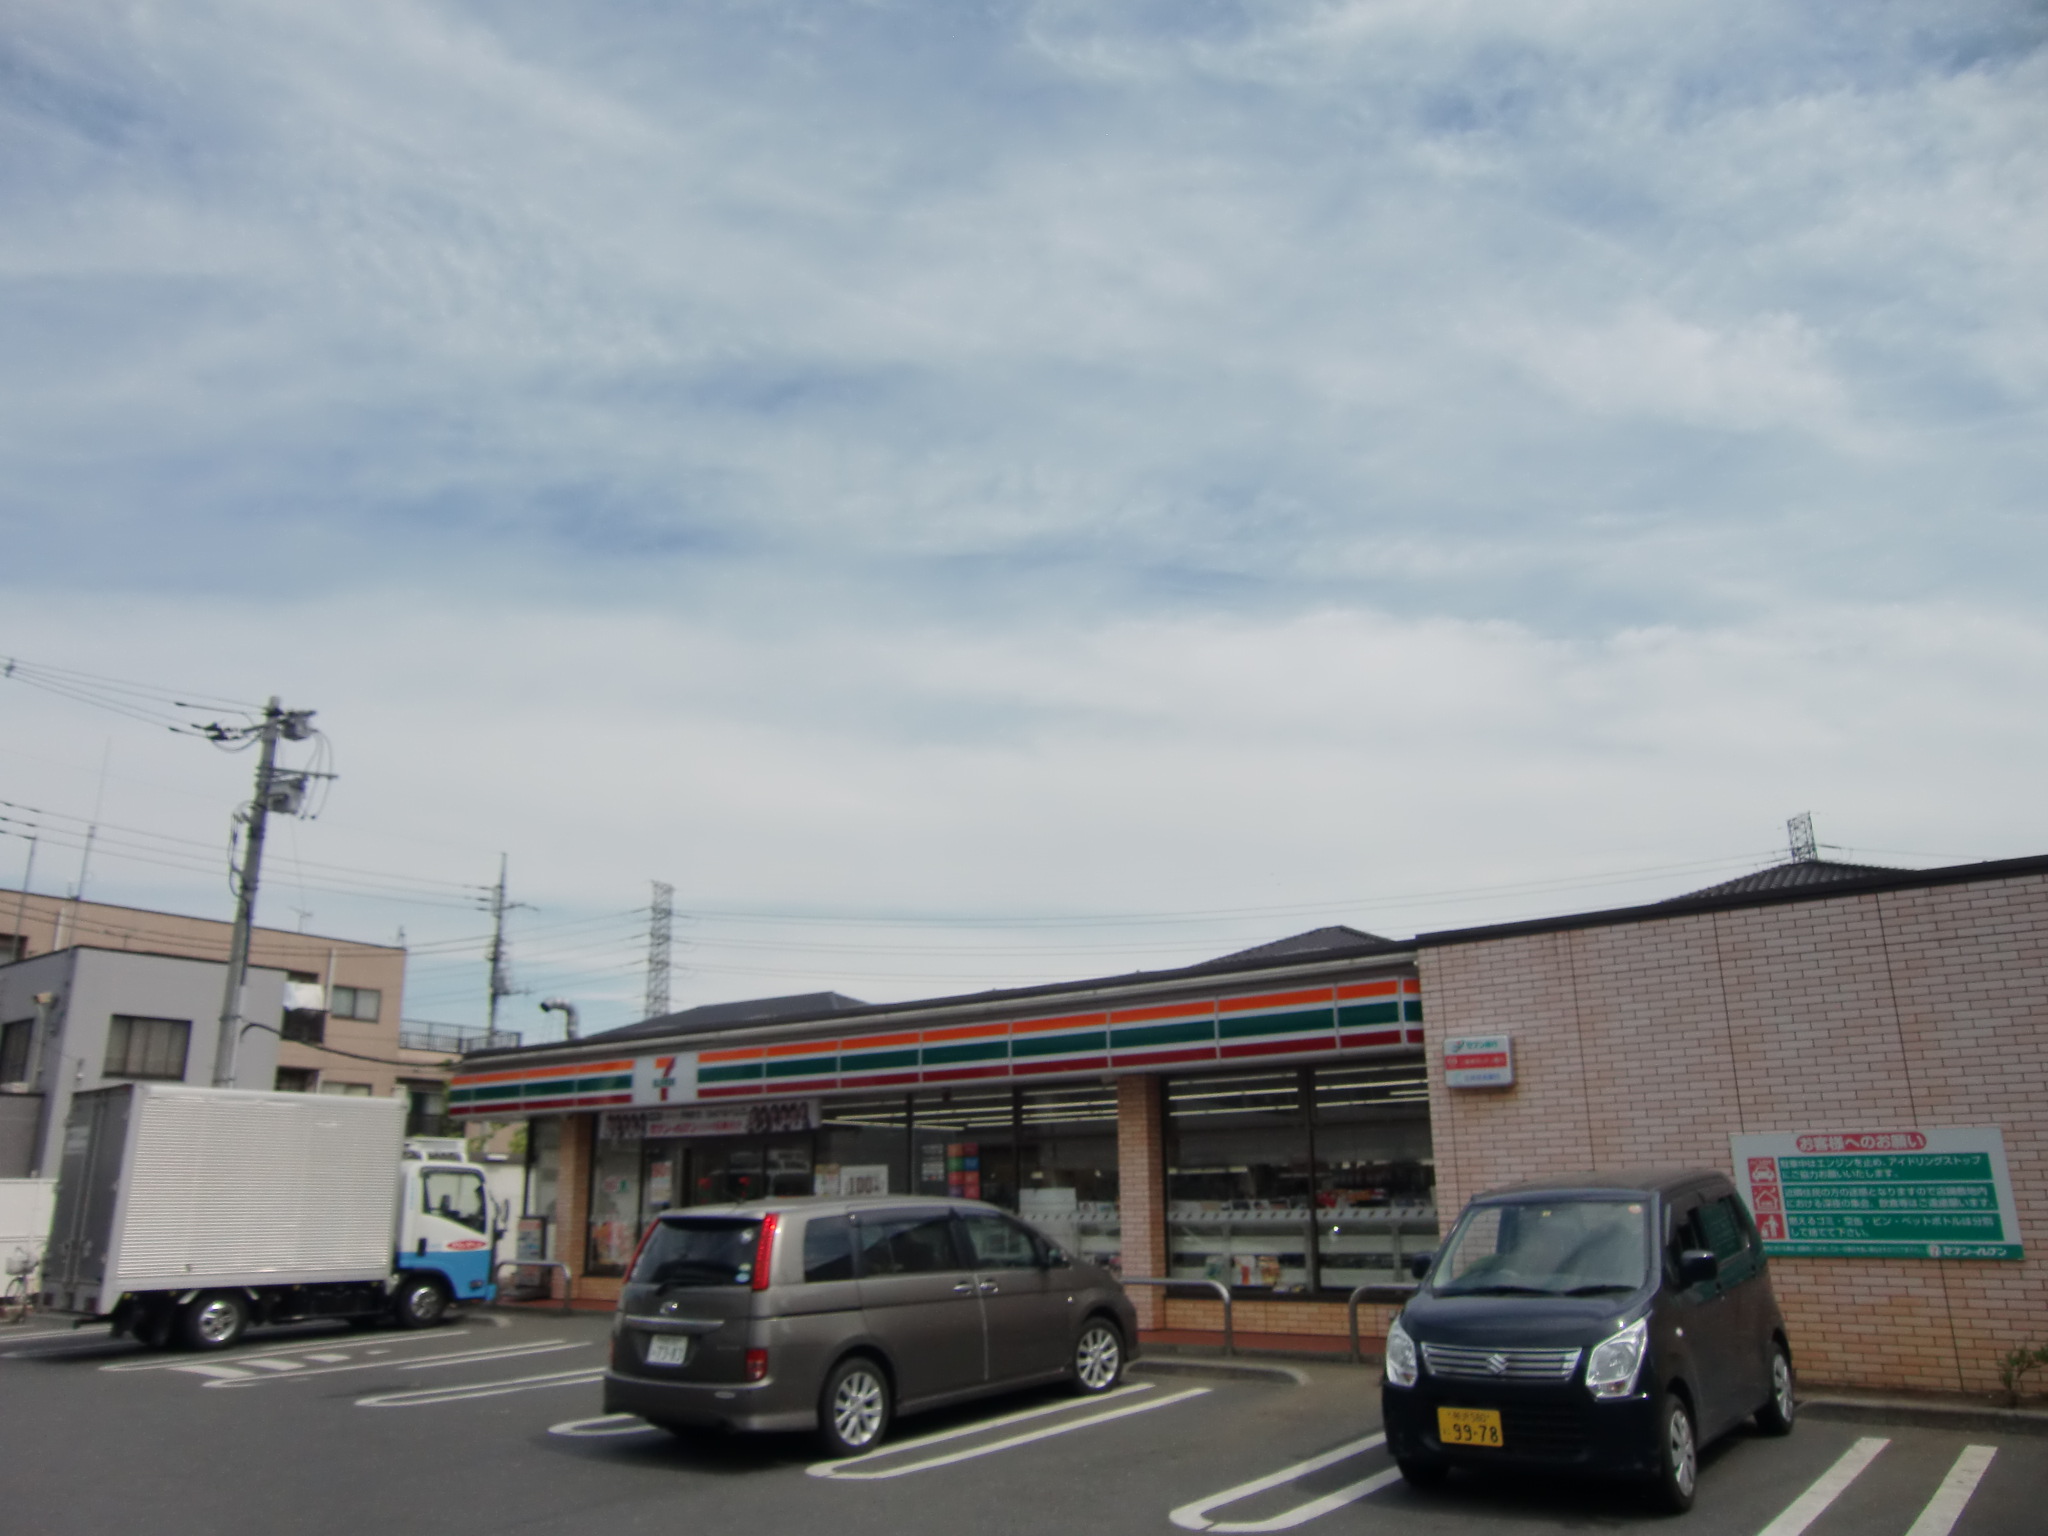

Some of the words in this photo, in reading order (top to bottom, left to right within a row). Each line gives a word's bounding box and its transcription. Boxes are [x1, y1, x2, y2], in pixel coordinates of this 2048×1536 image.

[1799, 1134, 1924, 1151] お客様へのお願い
